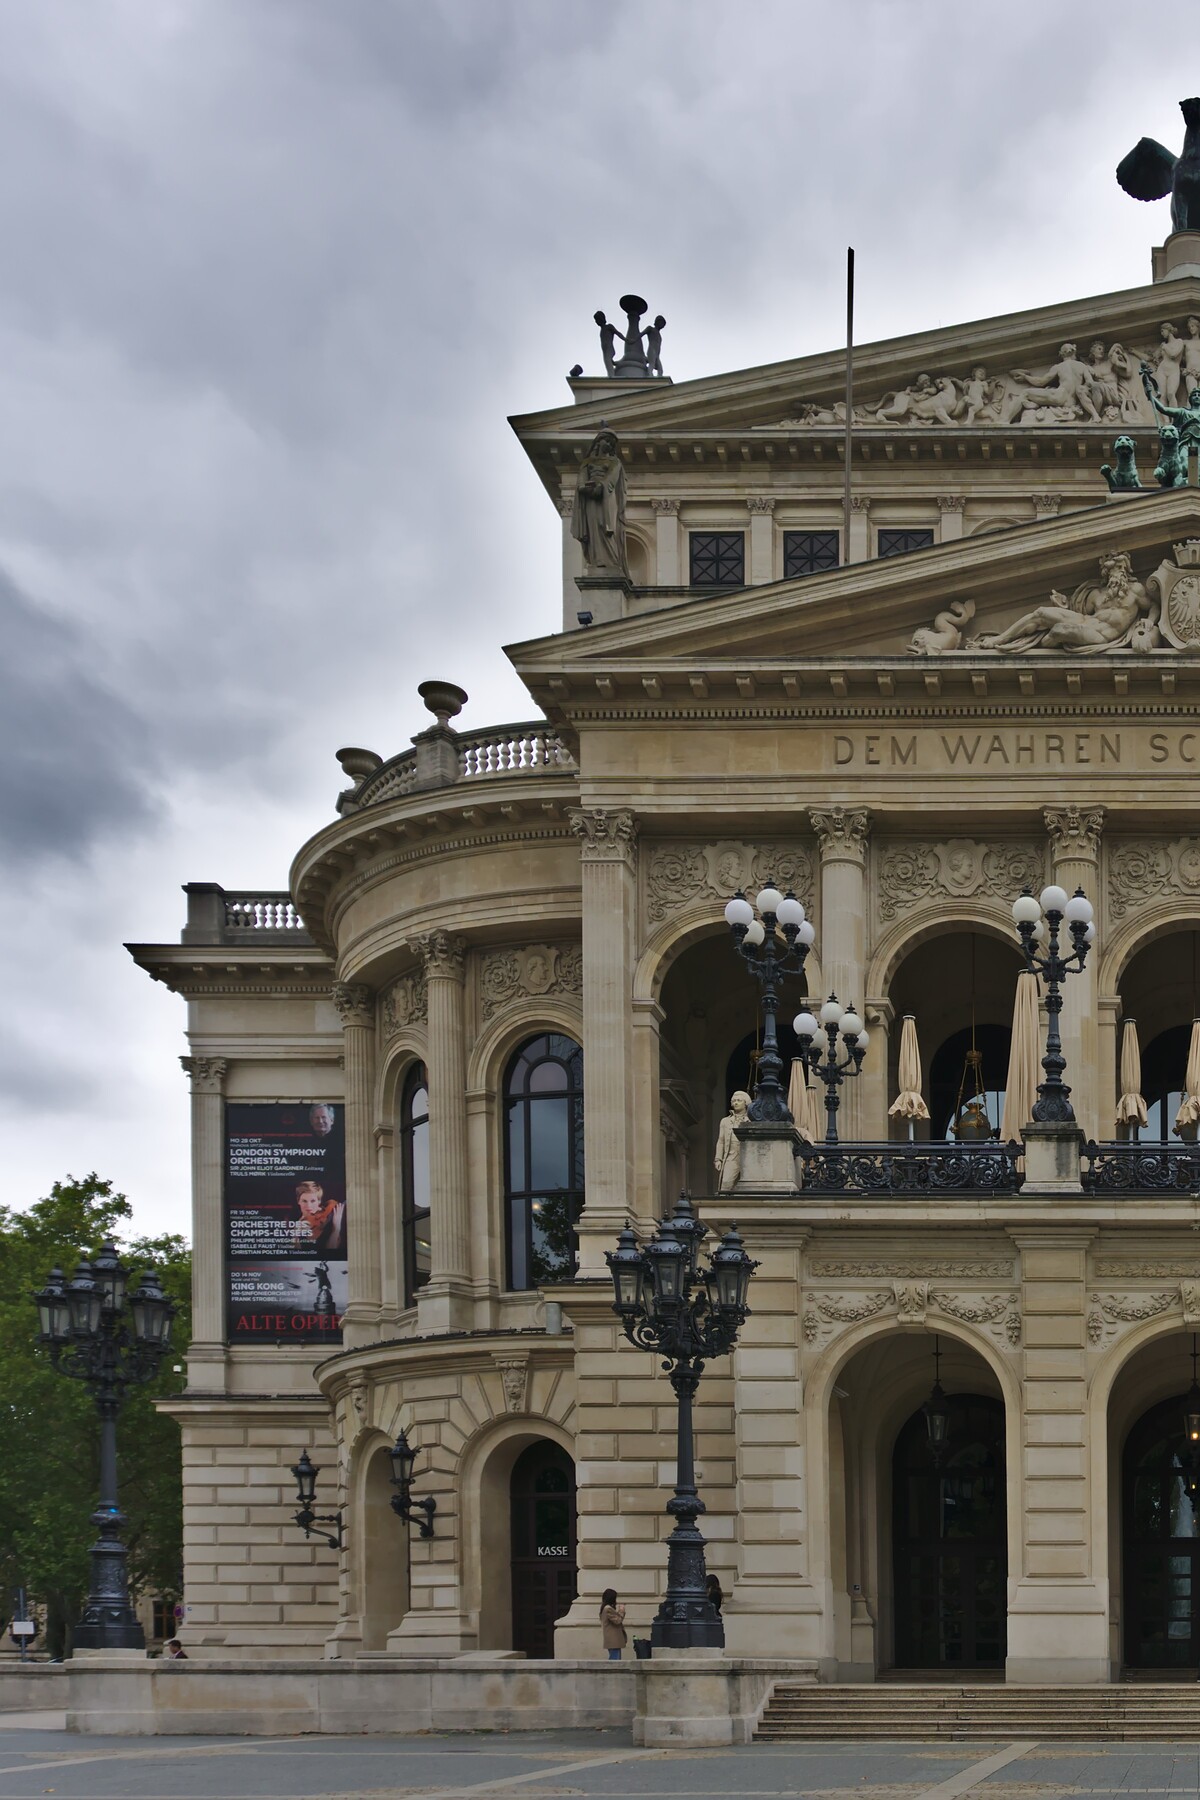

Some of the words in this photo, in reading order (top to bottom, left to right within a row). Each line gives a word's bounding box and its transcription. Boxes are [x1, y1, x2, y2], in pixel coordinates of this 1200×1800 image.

[833, 735, 918, 766] DEM
[940, 733, 1121, 765] WAHREN
[230, 1148, 271, 1156] LONDON
[273, 1148, 326, 1156] SYMPHONY
[230, 1157, 288, 1165] ORCHESTRA
[230, 1220, 287, 1228] ORCHESTRE
[288, 1220, 309, 1228] DES
[230, 1228, 313, 1237] CHAMPS-ÉLYSÉES
[231, 1282, 255, 1290] KING
[257, 1282, 285, 1290] KONG
[237, 1315, 286, 1330] ALTE
[538, 1546, 568, 1556] KASSE
